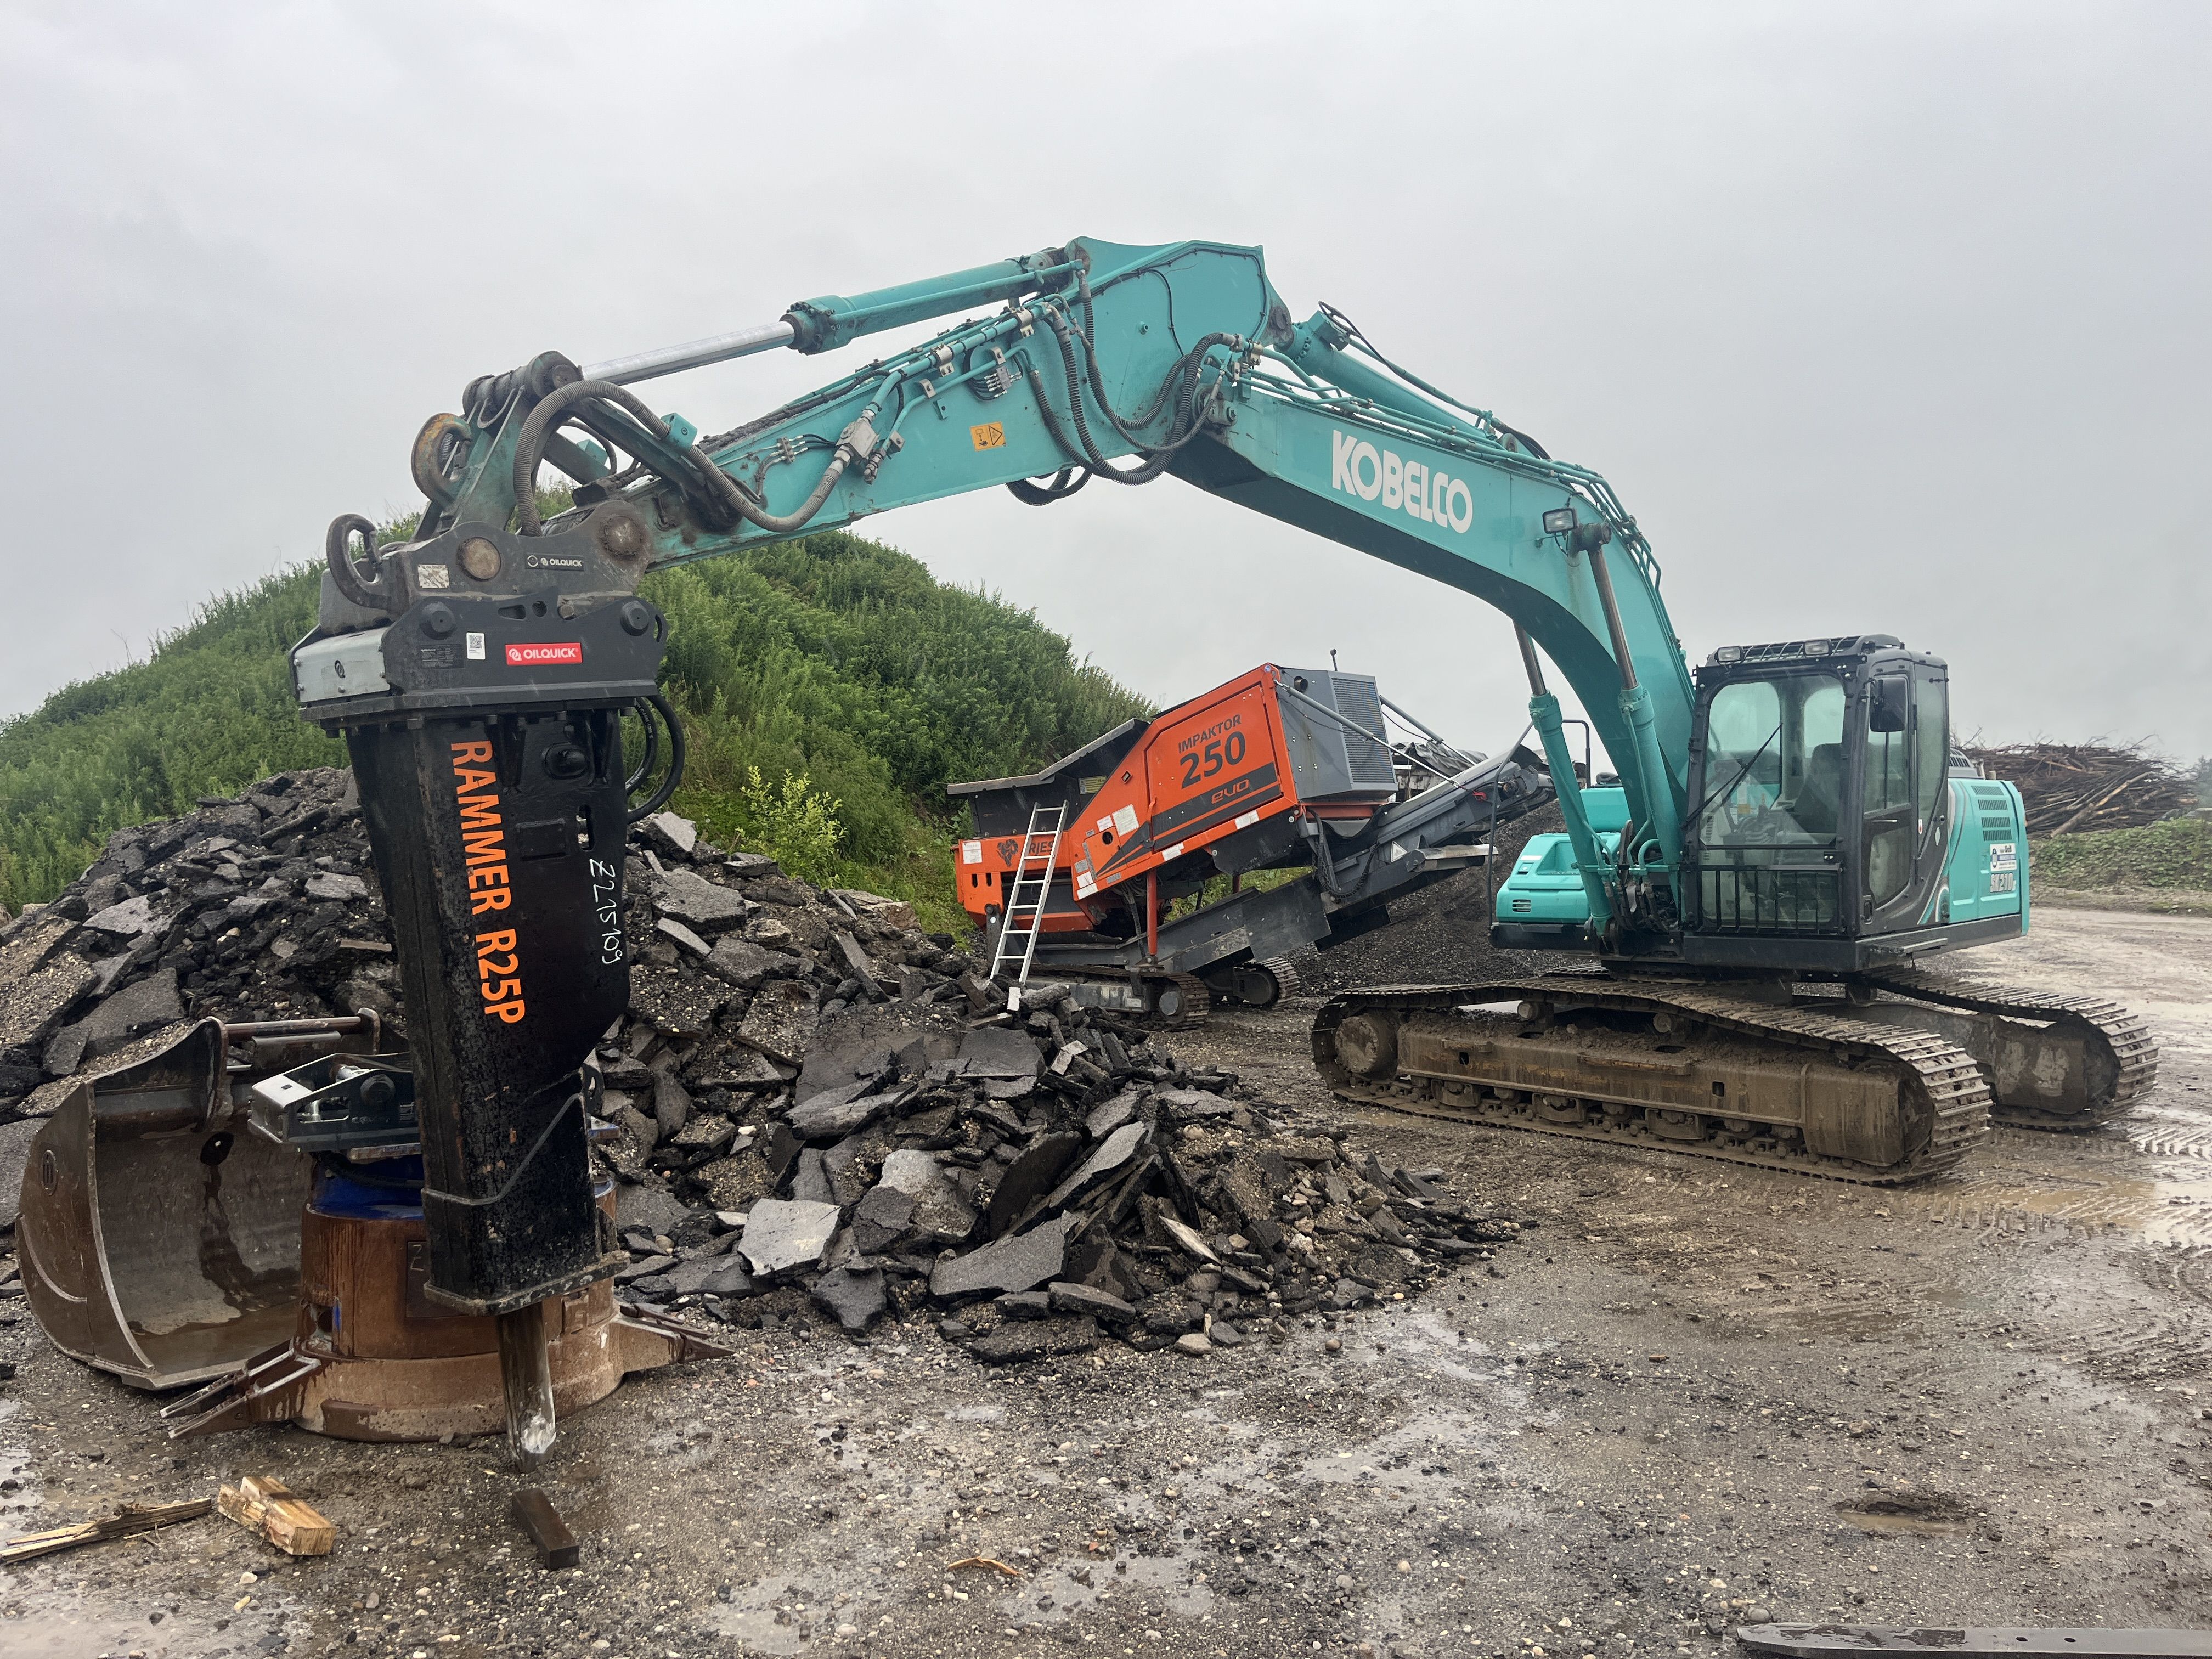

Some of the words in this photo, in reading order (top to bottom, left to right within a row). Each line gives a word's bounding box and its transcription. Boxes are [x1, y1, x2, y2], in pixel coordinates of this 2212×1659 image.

[1331, 429, 1474, 534] KOBELCO
[549, 558, 582, 567] OILQUICK
[523, 647, 577, 659] OILQUICK
[1178, 714, 1242, 754] IMPAKTOR
[1180, 731, 1246, 789] 250
[450, 740, 511, 916] RAMMER
[1029, 841, 1053, 856] RJES
[475, 928, 526, 1024] R25P
